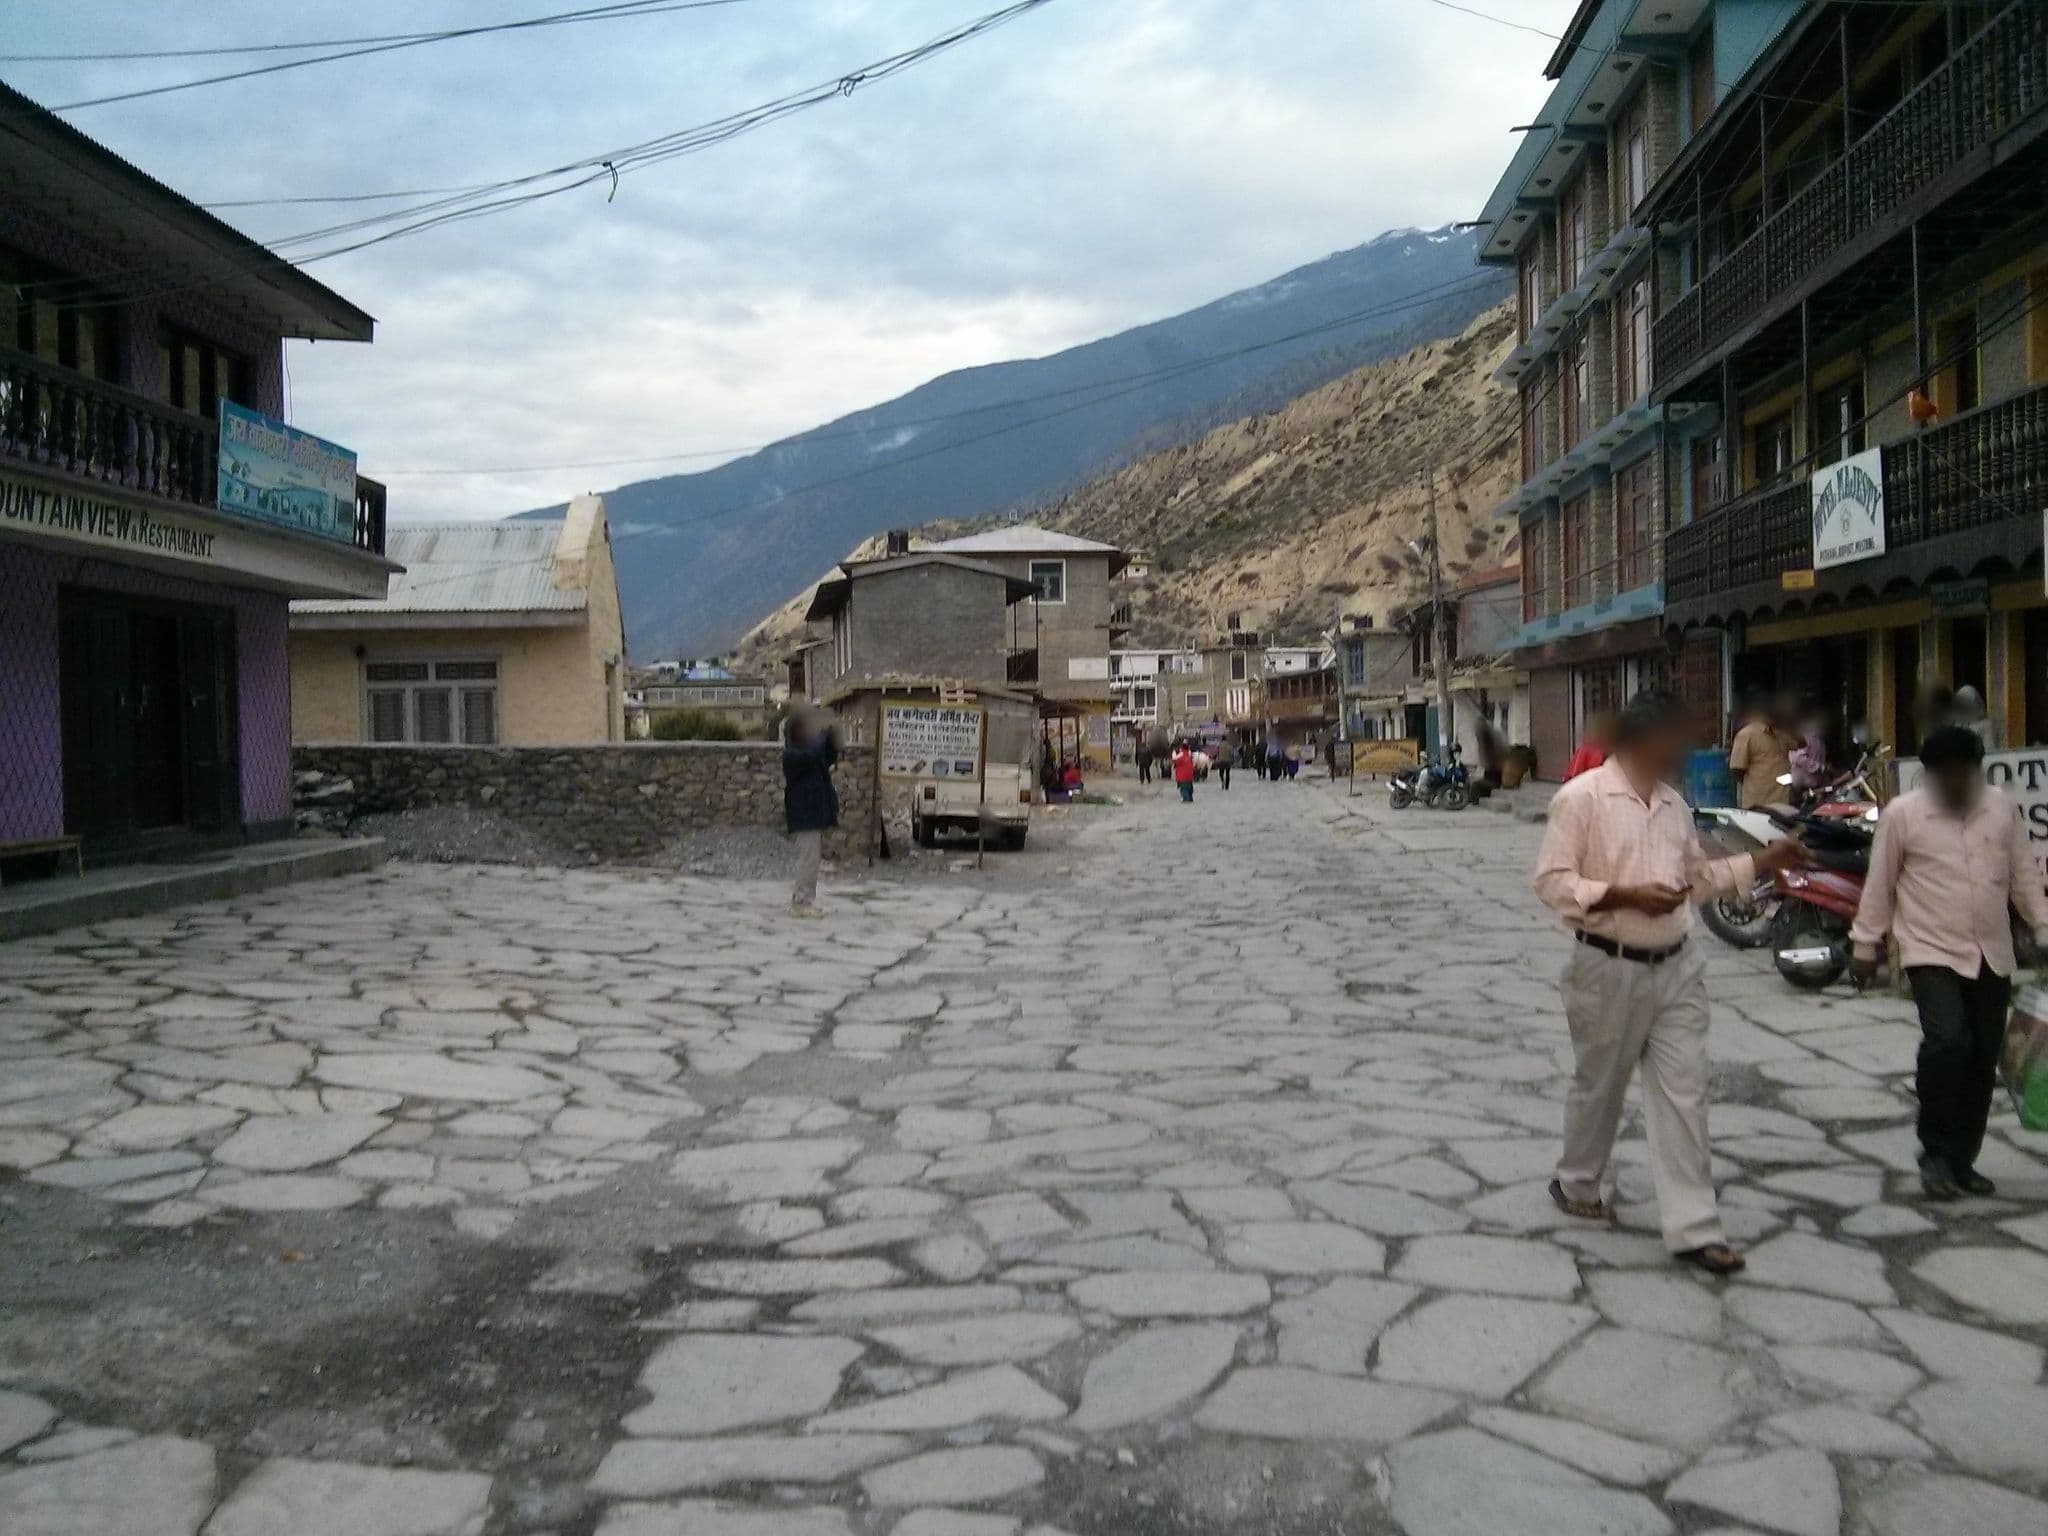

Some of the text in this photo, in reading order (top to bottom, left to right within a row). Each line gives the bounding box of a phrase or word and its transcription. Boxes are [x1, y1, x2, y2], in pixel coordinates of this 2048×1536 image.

[88, 501, 131, 540] VIEW
[1814, 465, 1881, 546] HOTEL MAJESTY
